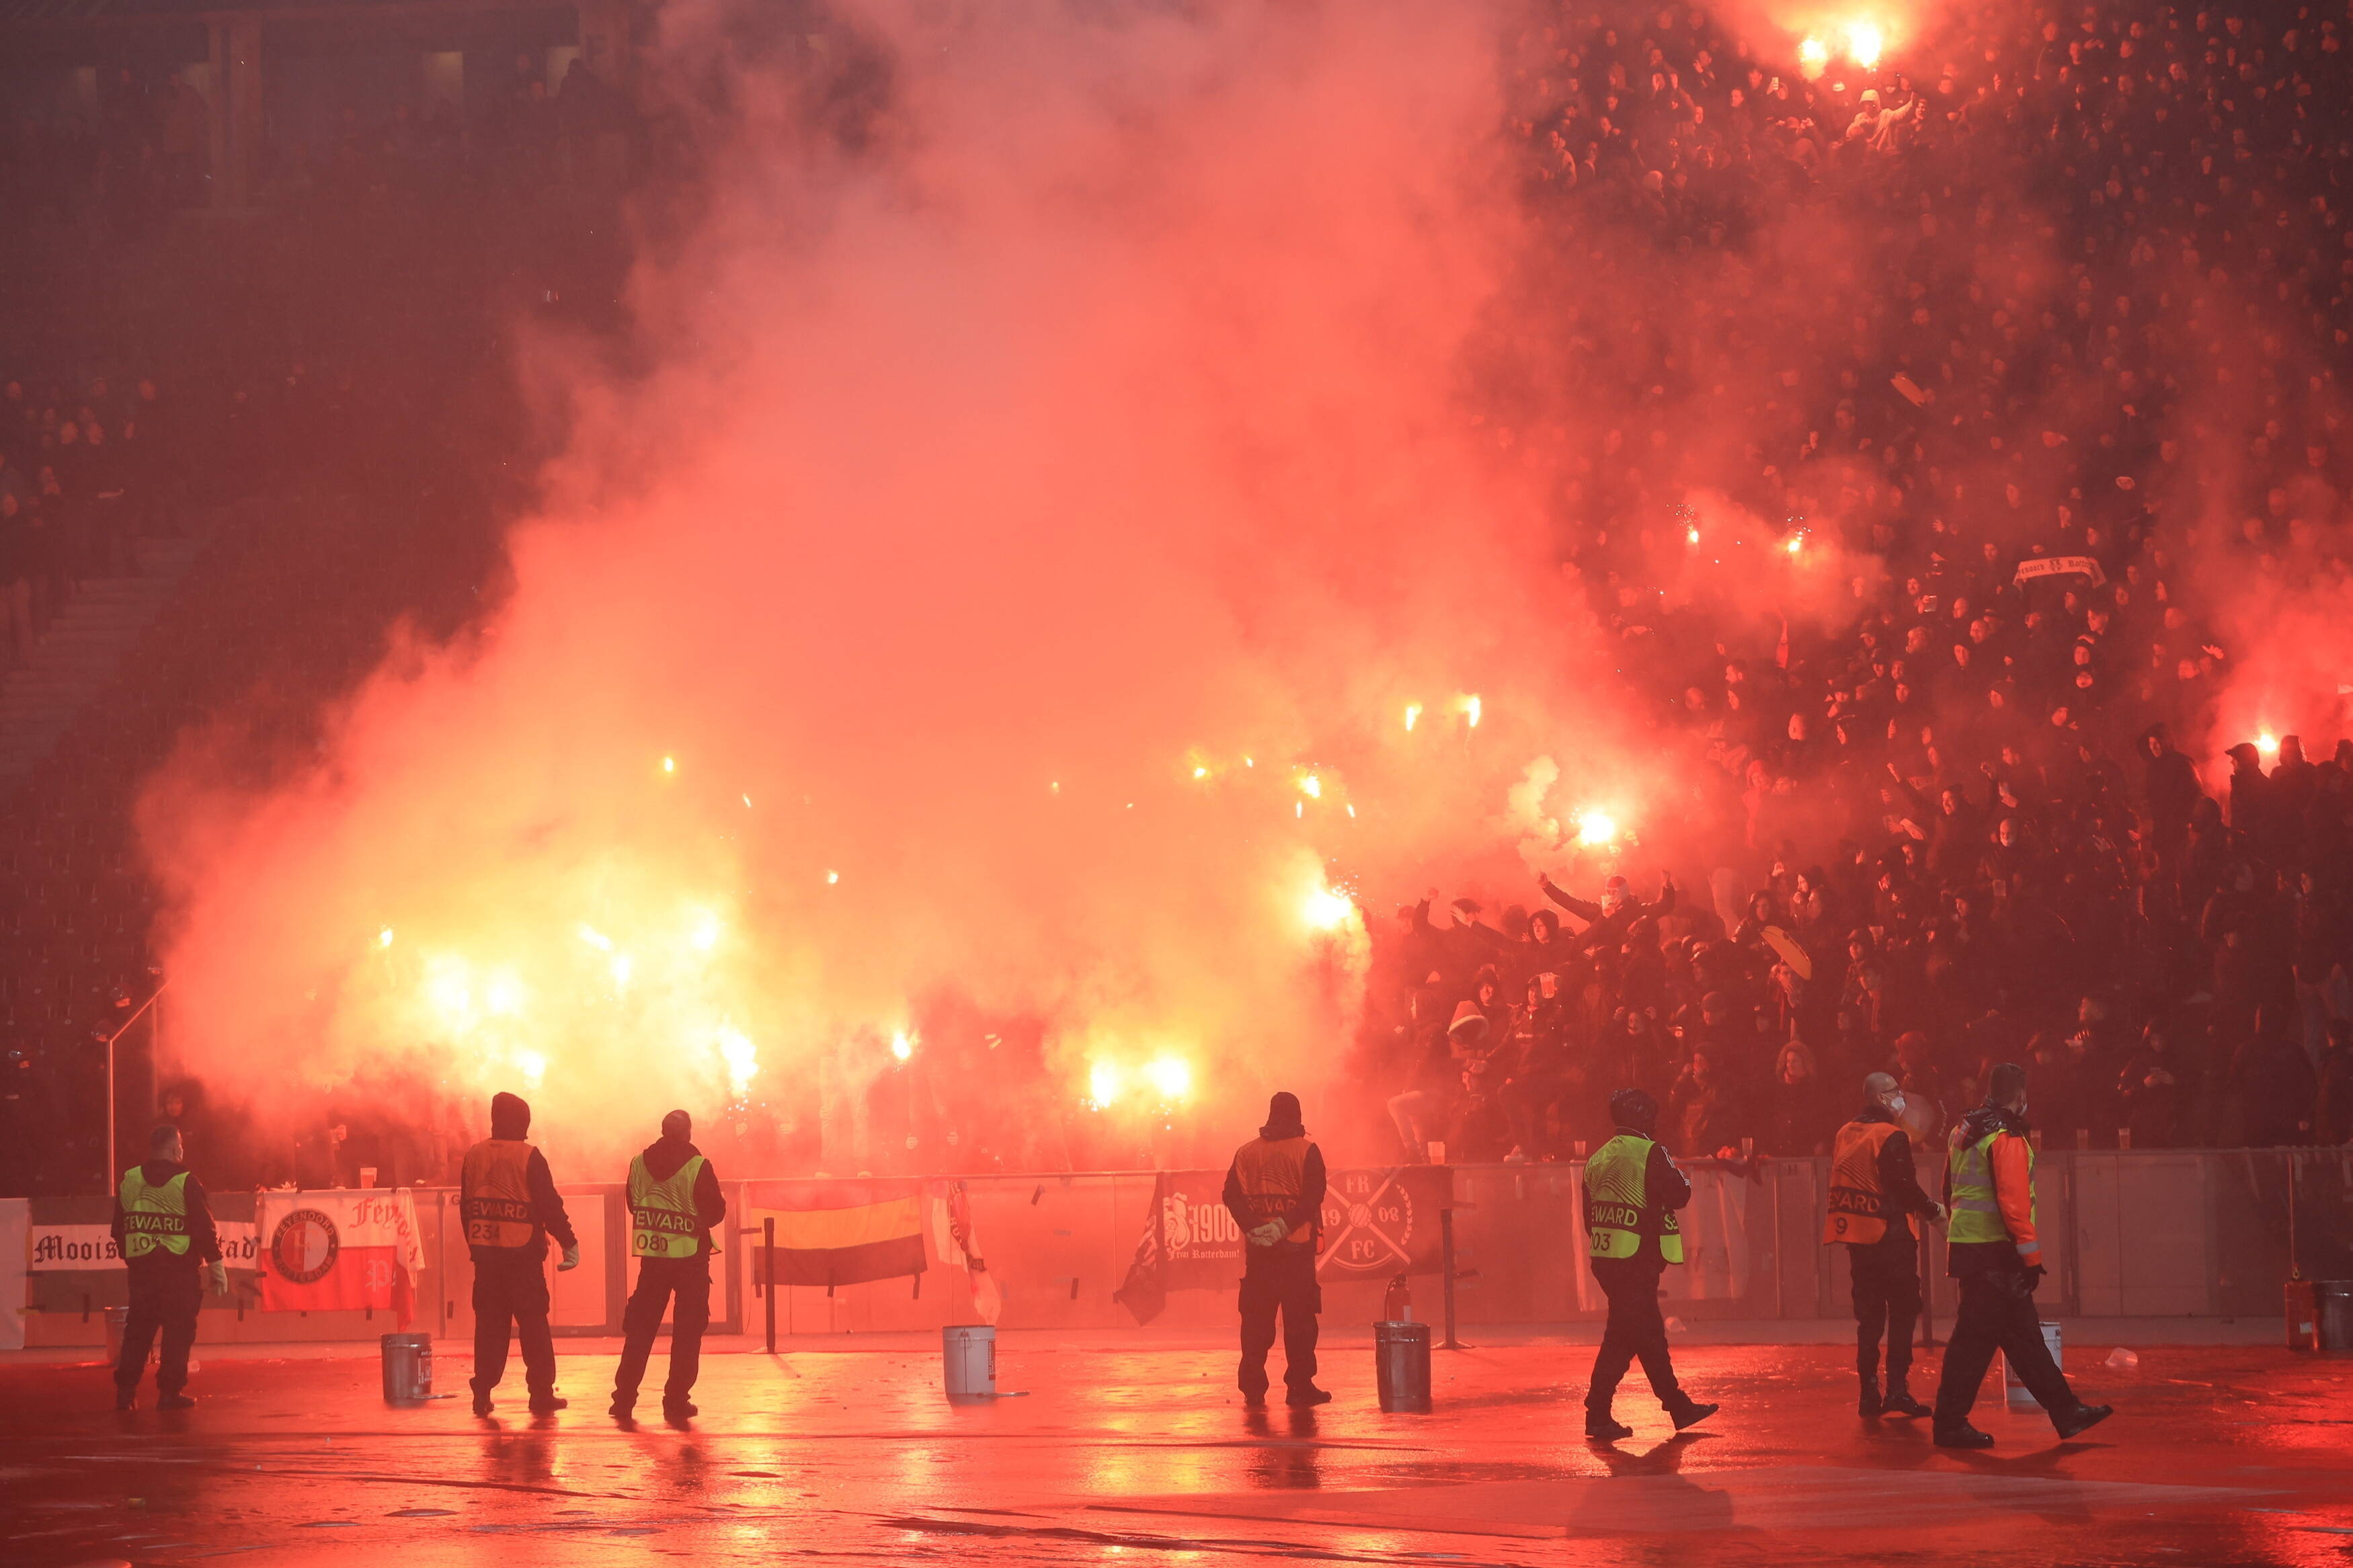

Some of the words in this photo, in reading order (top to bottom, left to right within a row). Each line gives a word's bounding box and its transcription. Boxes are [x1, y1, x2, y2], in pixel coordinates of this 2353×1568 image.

[2022, 563, 2044, 574] enoord
[1346, 1174, 1370, 1194] FR
[467, 1200, 528, 1219] EWARD
[1378, 1206, 1400, 1222] 08
[276, 1210, 335, 1239] FEYENOORD
[633, 1209, 696, 1232] EWARD
[34, 1235, 118, 1264] Moois
[217, 1236, 255, 1260] tad
[1351, 1239, 1375, 1260] FC
